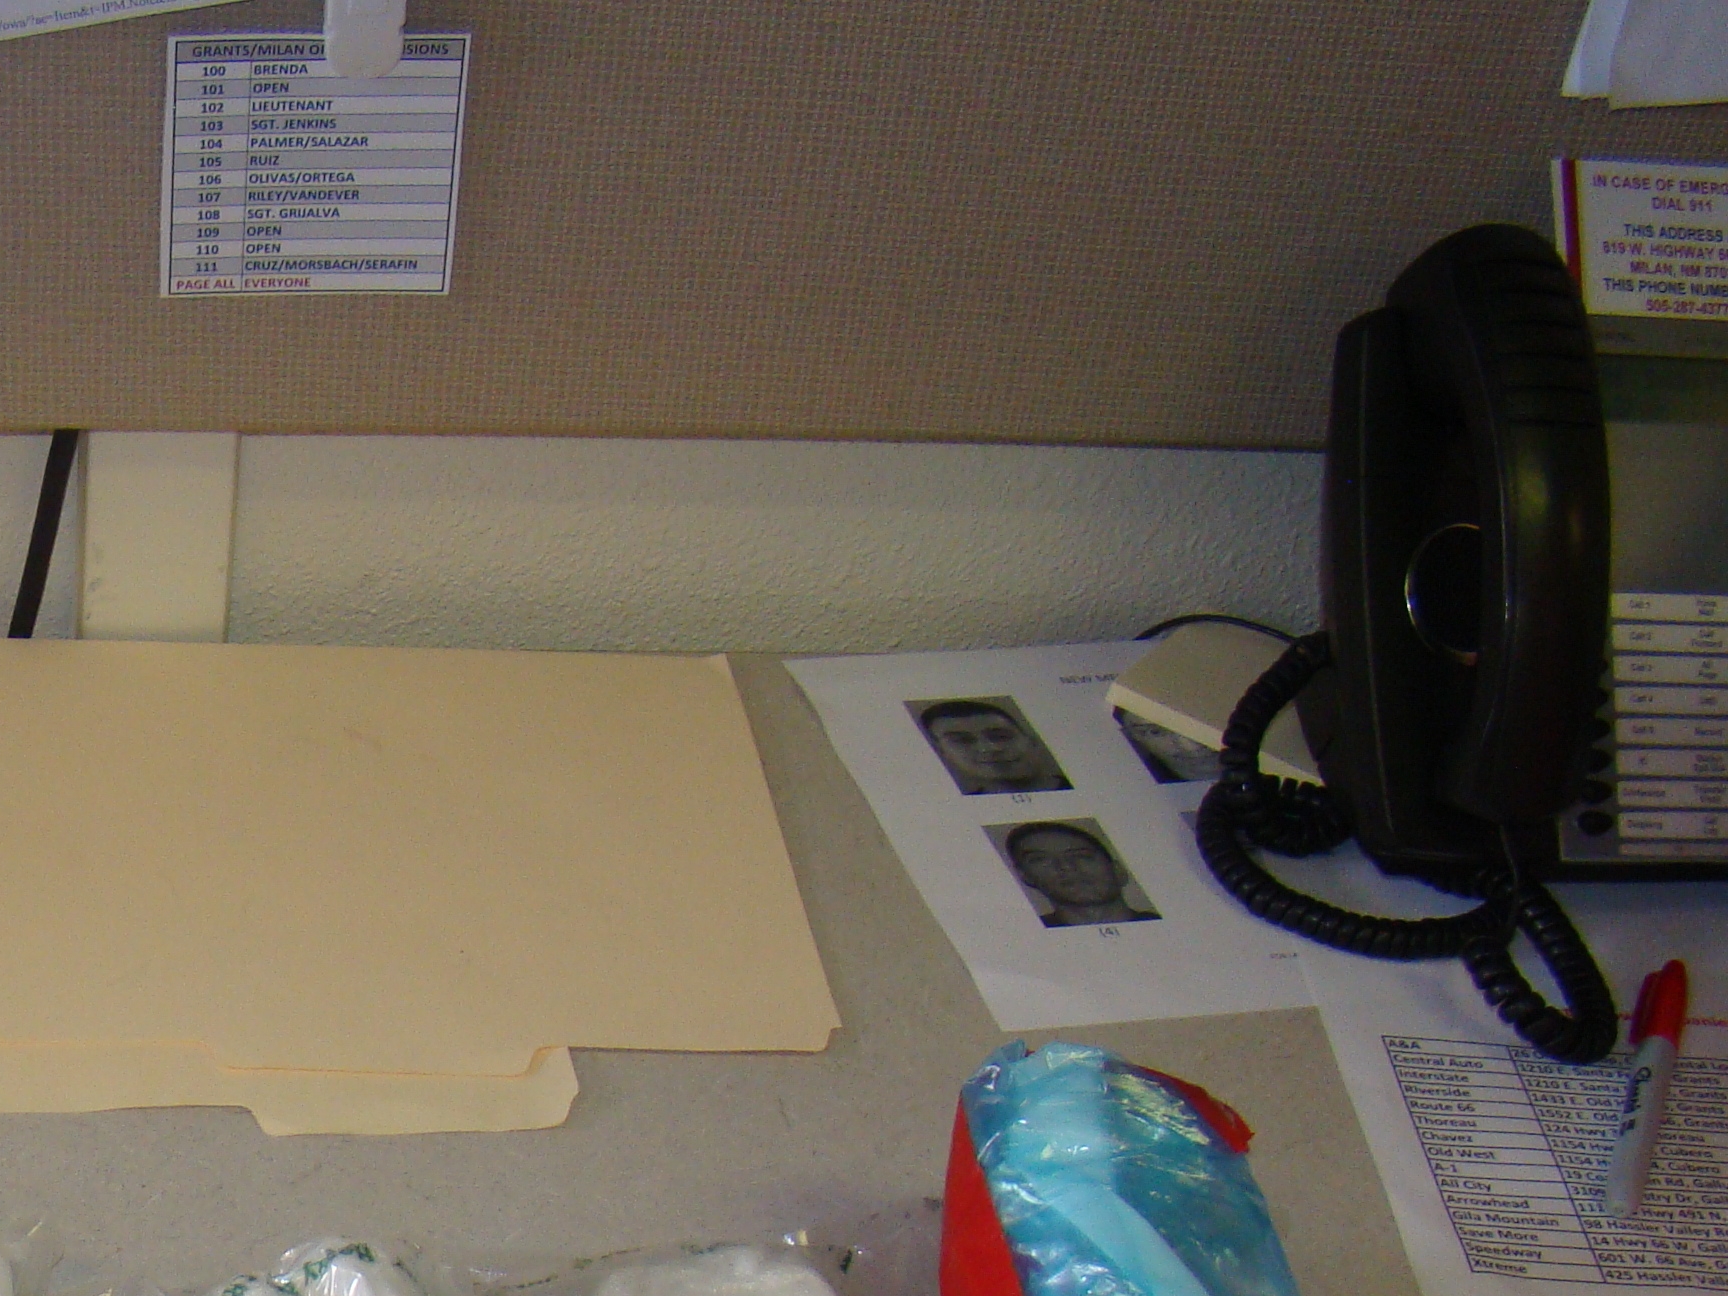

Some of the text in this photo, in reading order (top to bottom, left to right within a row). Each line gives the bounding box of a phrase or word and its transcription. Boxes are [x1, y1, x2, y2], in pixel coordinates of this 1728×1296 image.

[191, 44, 305, 58] GRANTS/MILAN
[402, 43, 450, 55] SIONS
[202, 63, 309, 77] 100 BRENDA
[201, 82, 290, 95] 101 OPEN
[200, 100, 334, 113] 102 LIEUTENANT
[199, 118, 337, 132] 103 SGT. JENKINS
[199, 135, 369, 150] 104 PALMER/SALAZAR
[198, 155, 280, 168] 105 RUIZ
[198, 171, 355, 186] 106 OLIVAS/ORTEGA
[1592, 174, 1607, 188] IN
[1611, 175, 1651, 190] CASE
[1655, 178, 1674, 191] OF
[197, 188, 360, 203] 107 RILEY/VANDEVER
[1651, 196, 1712, 212] DIAL 911
[196, 206, 341, 221] 108 SGT. GRIJALVA
[196, 225, 282, 238] 109 OPEN
[1624, 223, 1723, 242] THIS ADDRESS
[195, 243, 281, 255] 110 OPEN
[195, 258, 418, 273] 111 CRUZ/MORSBACH/SERAFIN
[176, 275, 312, 291] PAGE ALL EVERYONE
[1603, 277, 1634, 292] THIS
[1638, 280, 1686, 296] PHONE
[1394, 1053, 1445, 1066] Central
[1449, 1057, 1484, 1068] Auto
[1399, 1068, 1469, 1082] Interstate
[1579, 1082, 1620, 1093] Santa
[1403, 1084, 1472, 1097] Riverside
[1586, 1097, 1612, 1107] Old
[1409, 1100, 1452, 1111] Route
[1457, 1102, 1476, 1112] 66
[1593, 1112, 1619, 1122] Old
[1415, 1115, 1477, 1127] Thoreau
[1422, 1130, 1473, 1143] Chavez
[1428, 1146, 1453, 1156] Old
[1456, 1149, 1496, 1160] West
[1434, 1162, 1458, 1173] A-1
[1440, 1178, 1459, 1188] All
[1463, 1180, 1492, 1193] City
[1447, 1194, 1530, 1209] Arrowhead
[1452, 1210, 1481, 1222] Gila
[1485, 1213, 1560, 1226] Mountain
[1664, 1223, 1711, 1238] Valley
[1458, 1226, 1495, 1238] Save
[1497, 1229, 1540, 1241] More
[1613, 1236, 1647, 1249] Hwy
[1465, 1241, 1542, 1260] Speedway
[1471, 1257, 1528, 1274] Xtreme
[1606, 1270, 1633, 1281] 425
